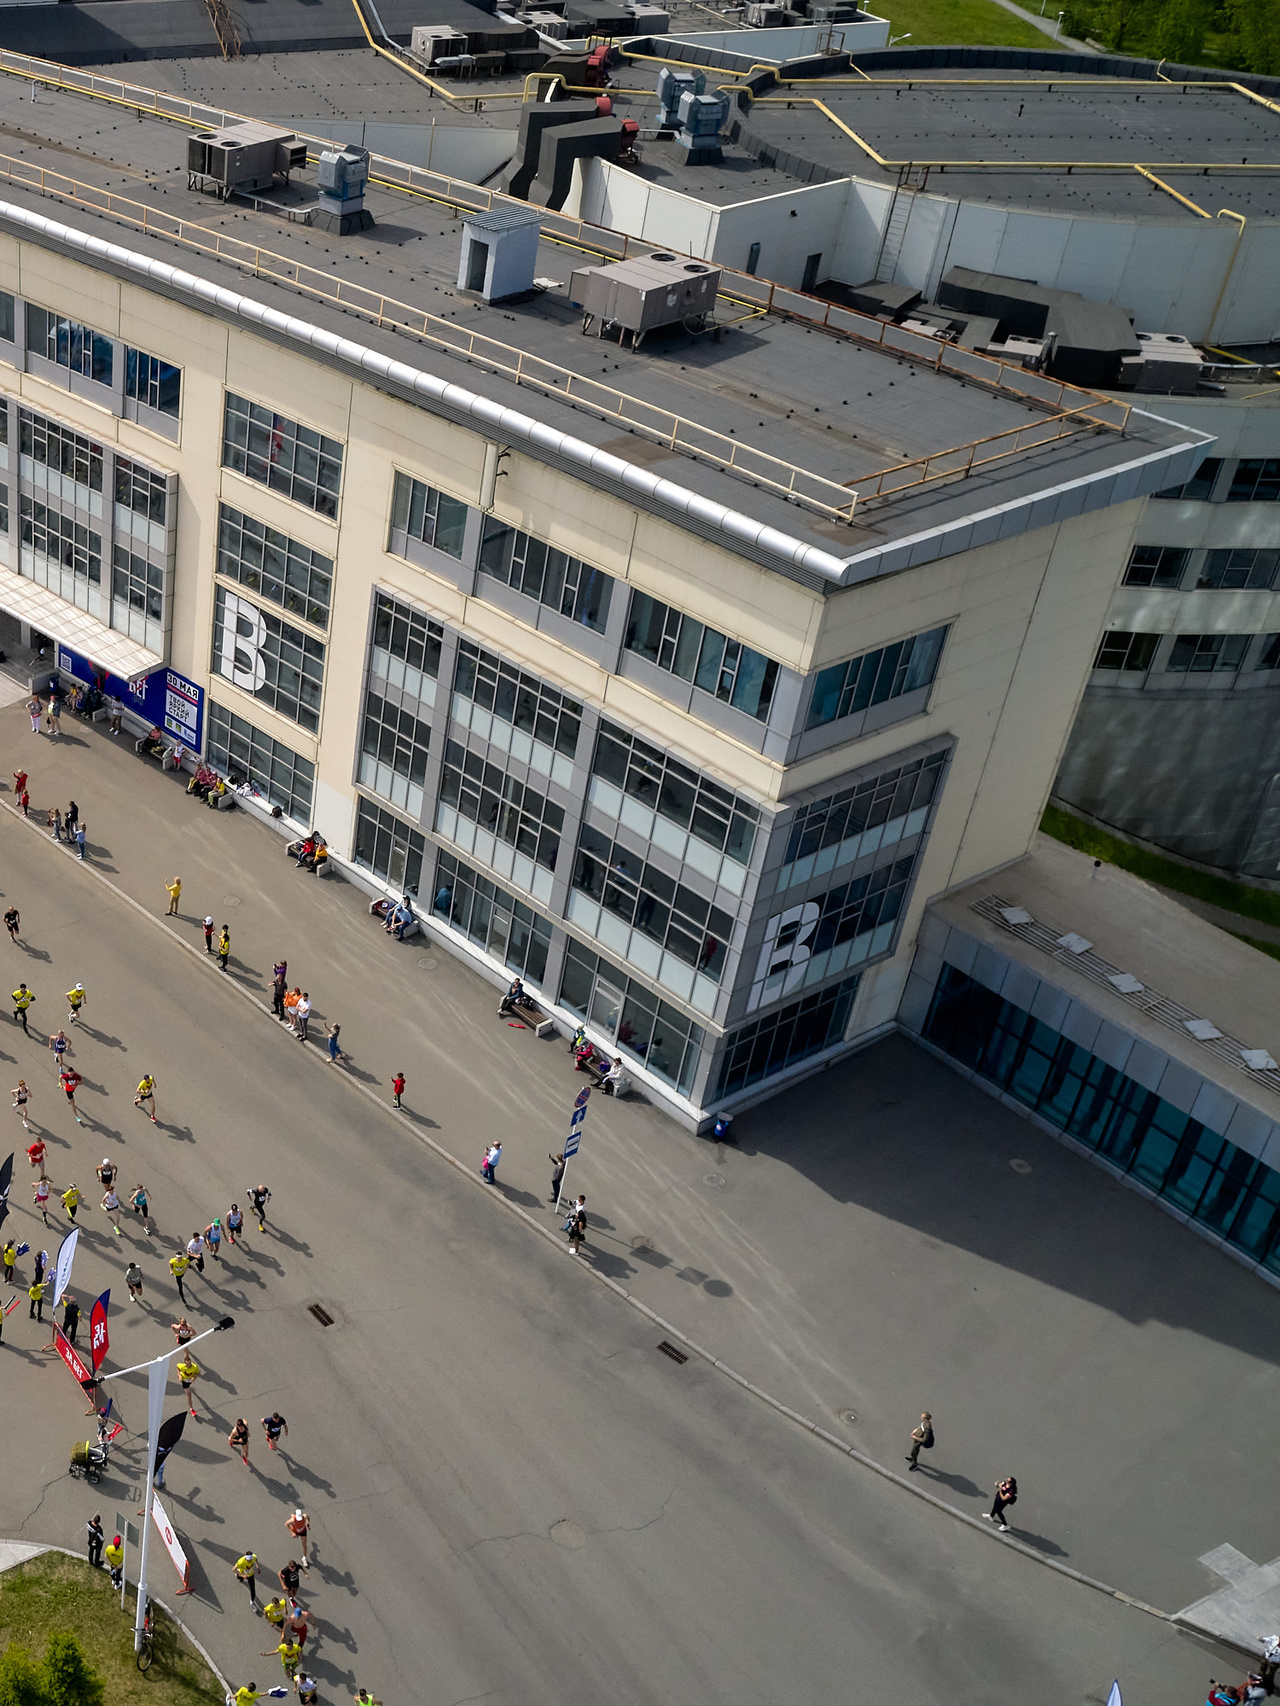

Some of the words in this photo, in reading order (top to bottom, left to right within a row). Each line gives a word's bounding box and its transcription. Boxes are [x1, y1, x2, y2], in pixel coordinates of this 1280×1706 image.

[167, 674, 178, 686] 30
[179, 681, 198, 699] МАЯ
[169, 694, 186, 709] ТВОЙ
[169, 701, 190, 718] ЯРКИЙ
[168, 707, 188, 722] СТАРТ
